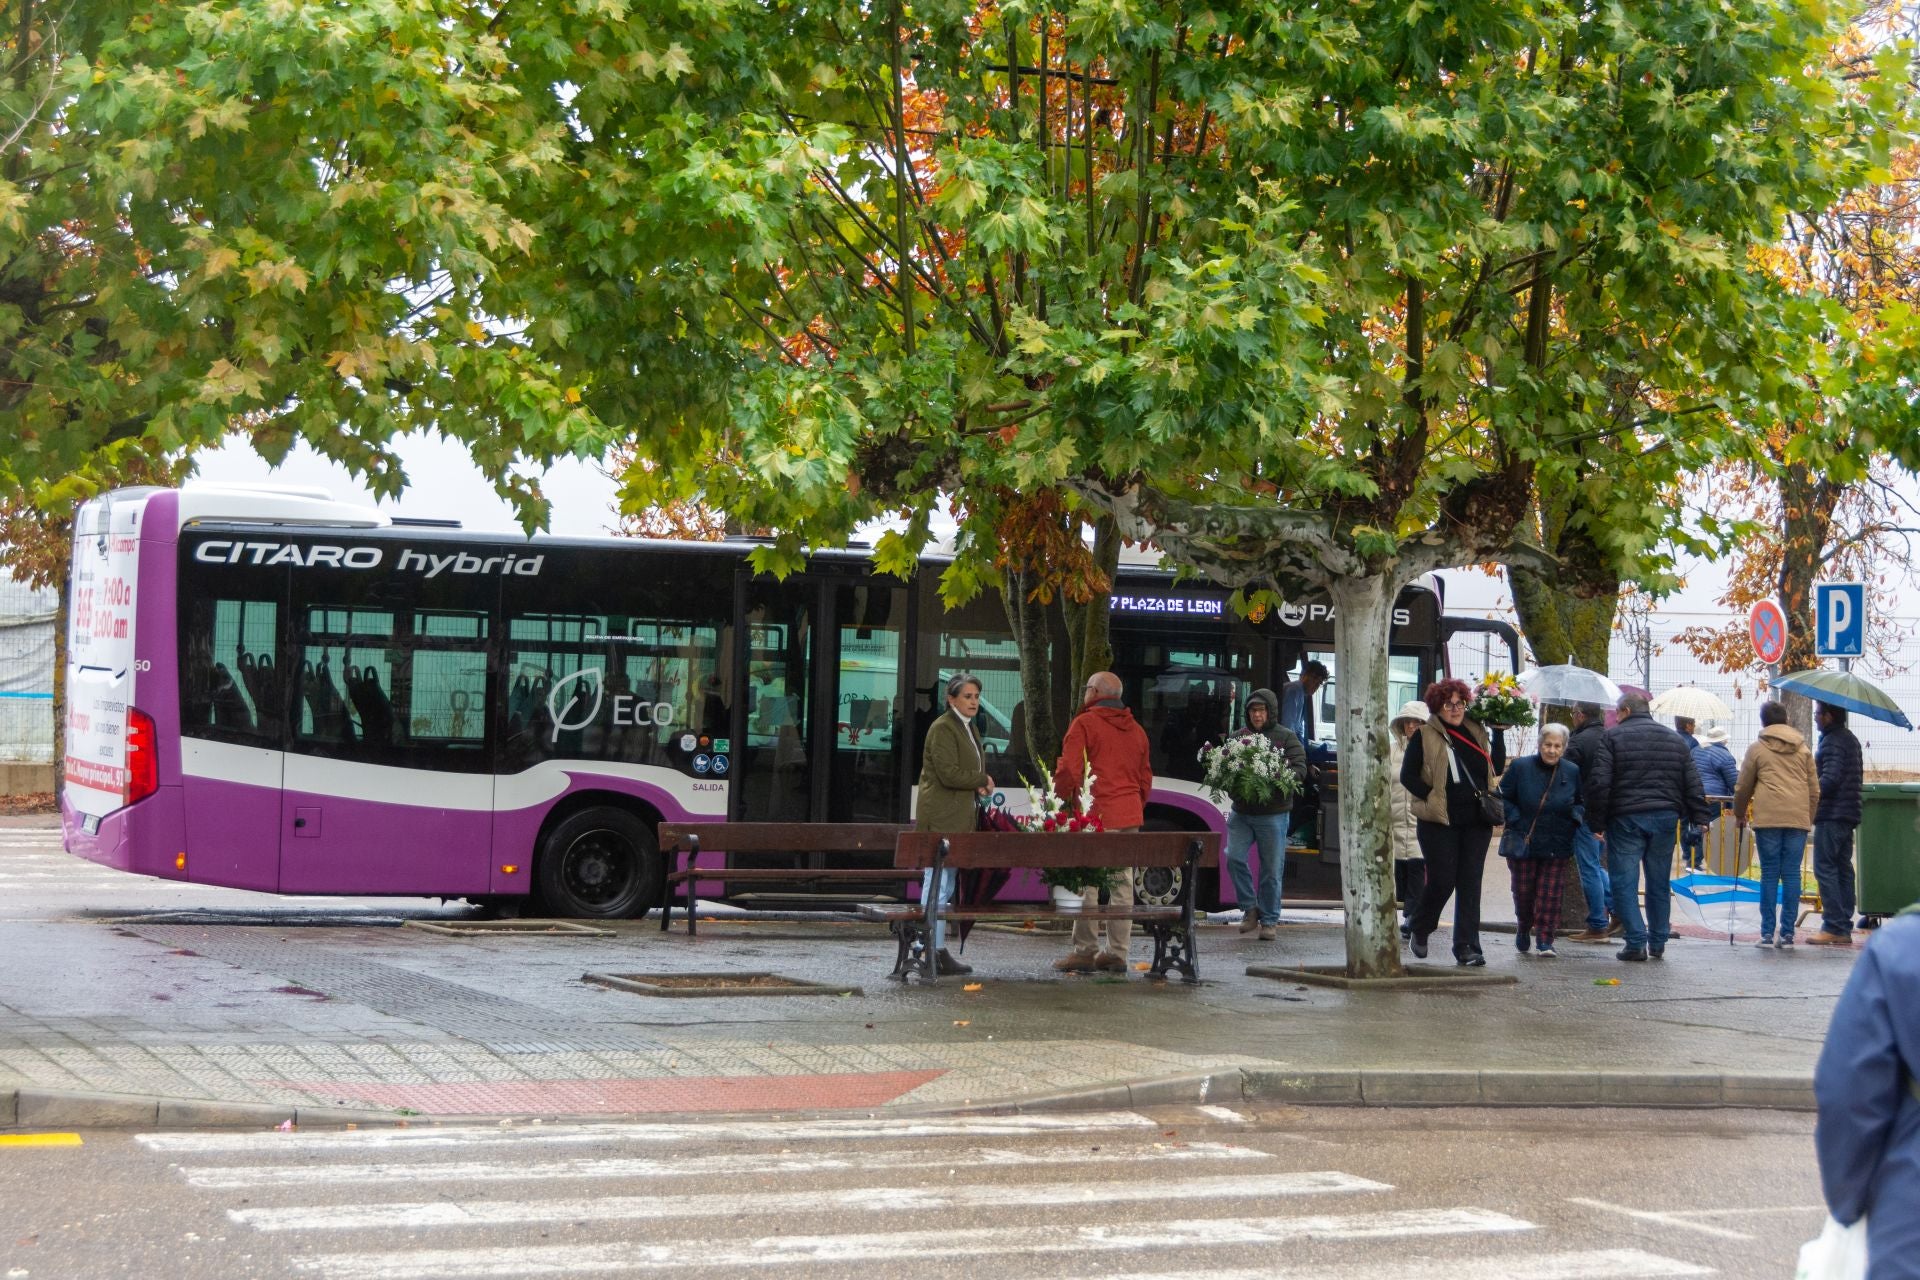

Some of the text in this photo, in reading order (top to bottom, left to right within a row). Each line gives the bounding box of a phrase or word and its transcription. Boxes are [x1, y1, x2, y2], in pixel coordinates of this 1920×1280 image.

[195, 540, 545, 578] CITARO hybrid
[1121, 597, 1165, 611] PLAZA
[1167, 599, 1184, 612] DE
[1188, 600, 1221, 613] LEON
[113, 617, 128, 639] am
[1828, 589, 1851, 650] P
[692, 783, 724, 792] SALIDA
